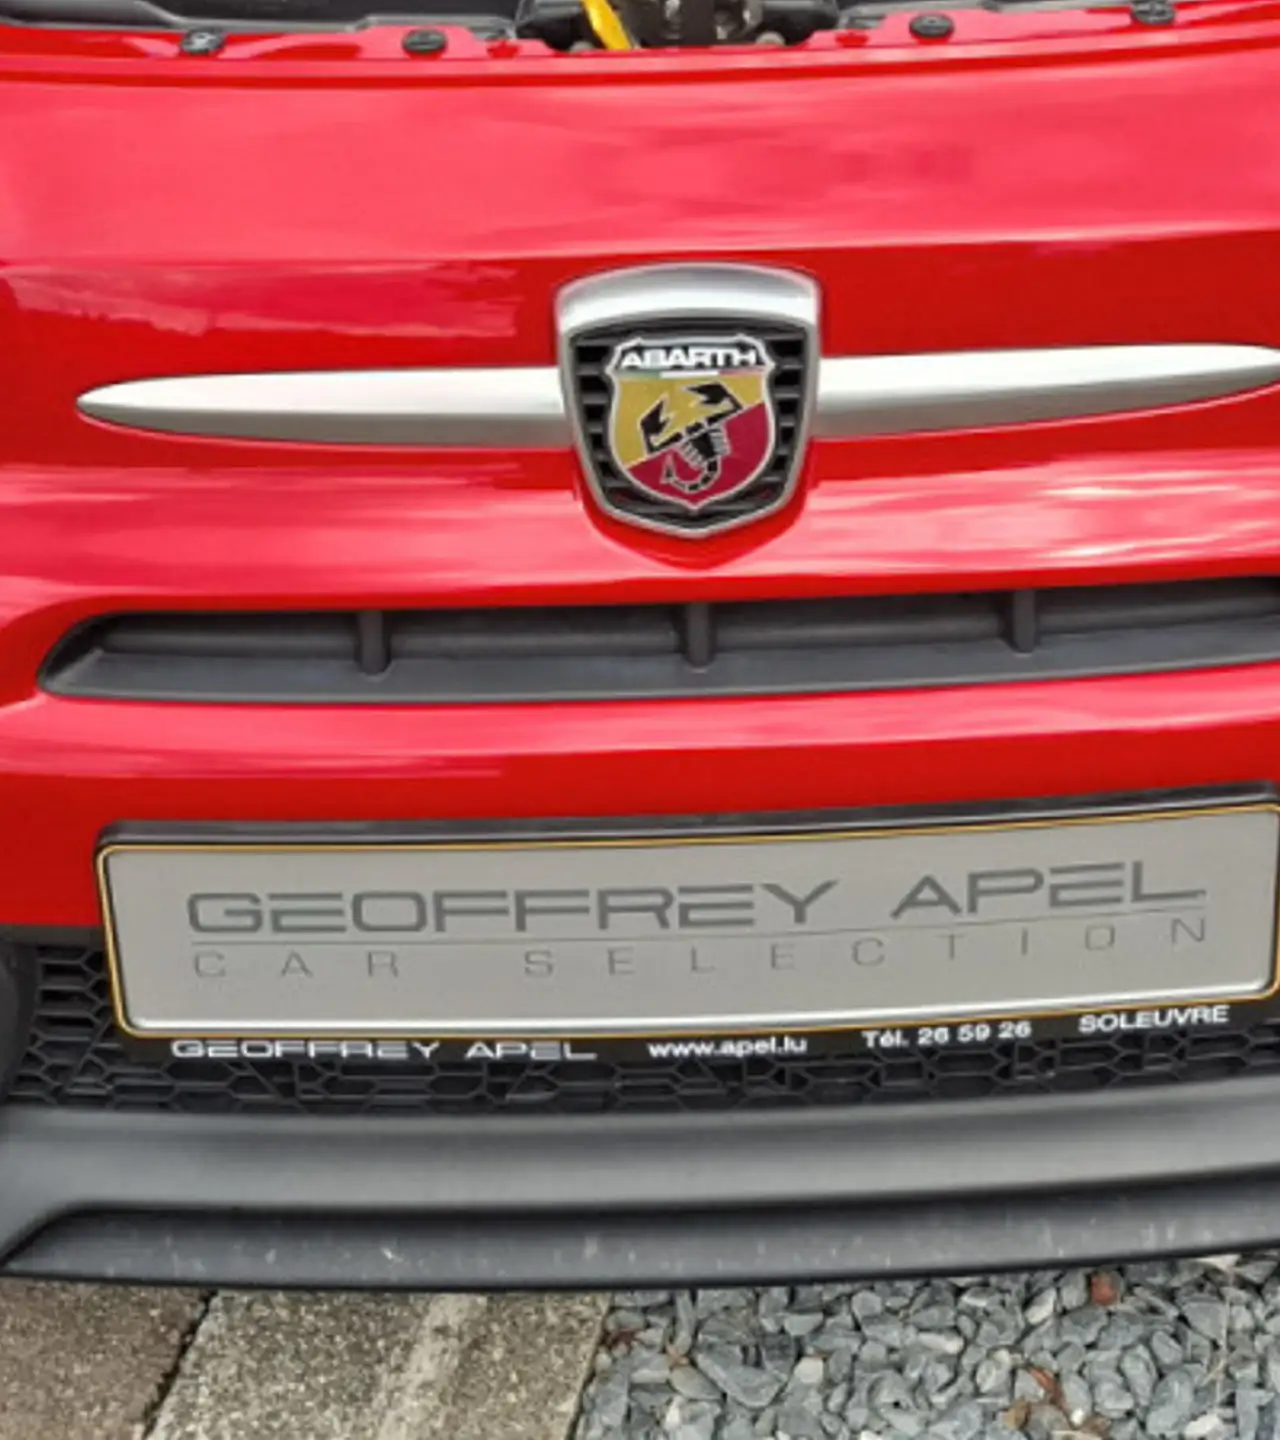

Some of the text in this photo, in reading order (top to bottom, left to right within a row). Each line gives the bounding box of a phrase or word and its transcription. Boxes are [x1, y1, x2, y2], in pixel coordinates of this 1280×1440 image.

[621, 348, 757, 367] ABARTH
[186, 861, 1207, 934] GEOFFREY APEL
[193, 915, 1207, 979] CAR SELECTION
[1077, 1004, 1231, 1035] SOLEUVRE
[170, 1038, 598, 1060] GEOFFREY APEL
[647, 1034, 808, 1058] www.apel.lu
[862, 1020, 1032, 1049] Tél. 26 59 26
